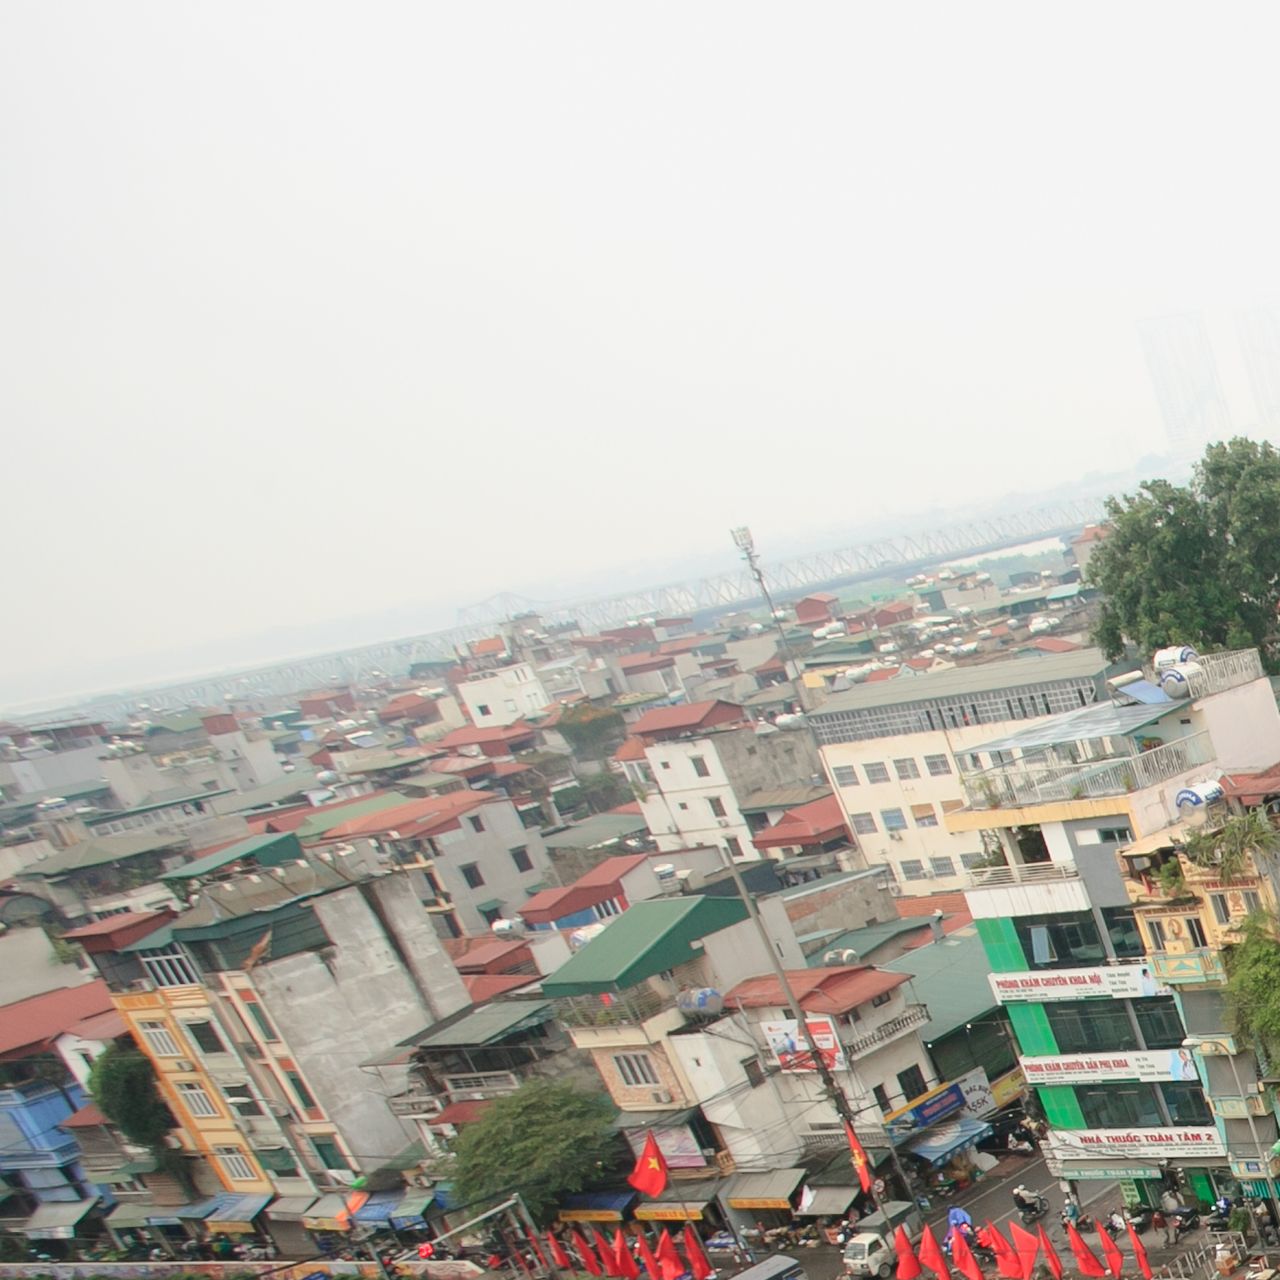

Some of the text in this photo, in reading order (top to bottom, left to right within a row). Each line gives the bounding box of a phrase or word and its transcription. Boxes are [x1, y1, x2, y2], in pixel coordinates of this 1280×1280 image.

[995, 978, 1020, 990] PHÒNG
[1020, 976, 1041, 988] KHÁM
[1041, 974, 1069, 987] CHUYÊN
[1069, 975, 1089, 985] KHOA
[1088, 972, 1102, 987] NỘI
[1024, 1062, 1044, 1073] PHÒNG
[1044, 1060, 1062, 1071] KHÁM
[1062, 1059, 1085, 1070] CHUYÊN
[1112, 1058, 1129, 1068] KHOA
[1080, 1131, 1214, 1144] NHÀ THUỐC TOÀN TÂM 2
